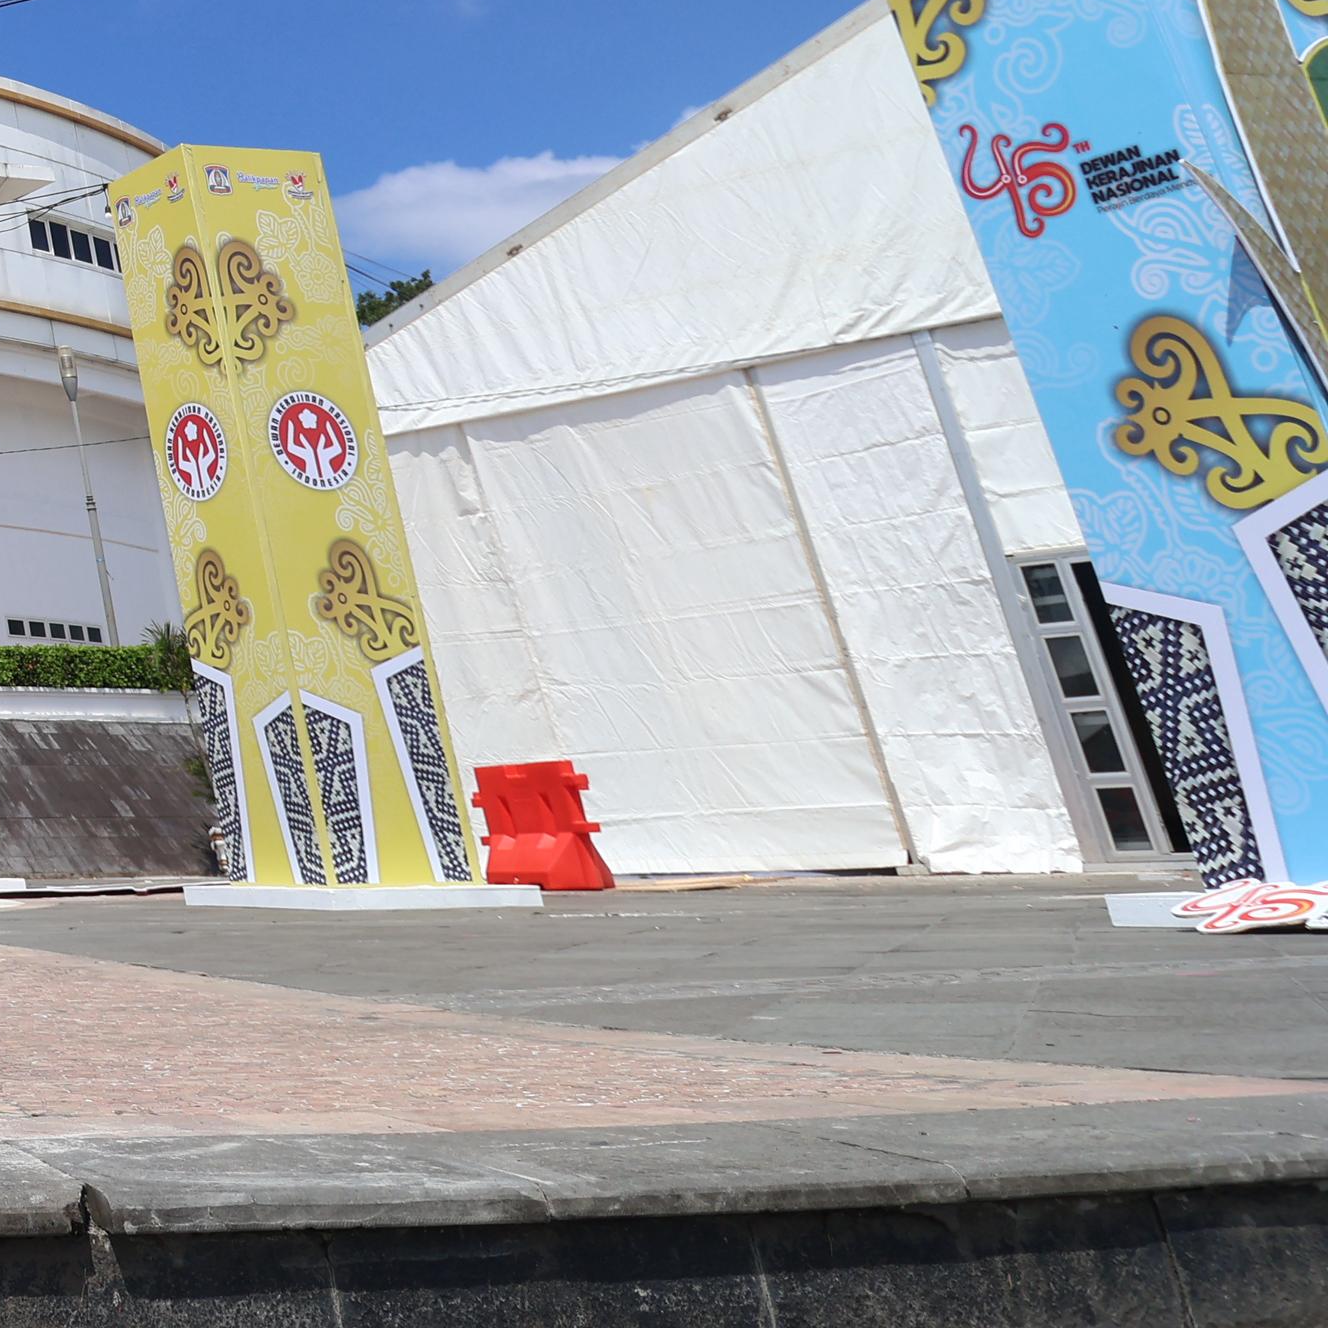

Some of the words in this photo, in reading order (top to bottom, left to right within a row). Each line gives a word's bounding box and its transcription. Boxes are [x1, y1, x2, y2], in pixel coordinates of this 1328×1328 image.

[1072, 140, 1091, 154] TH
[1079, 145, 1142, 175] DEWAN
[1084, 149, 1181, 191] KERAJINAN
[1091, 168, 1180, 205] NASIONAL
[270, 417, 284, 456] DEWAN
[328, 406, 355, 456] NASIONAL
[292, 468, 350, 488] INDONESIA
